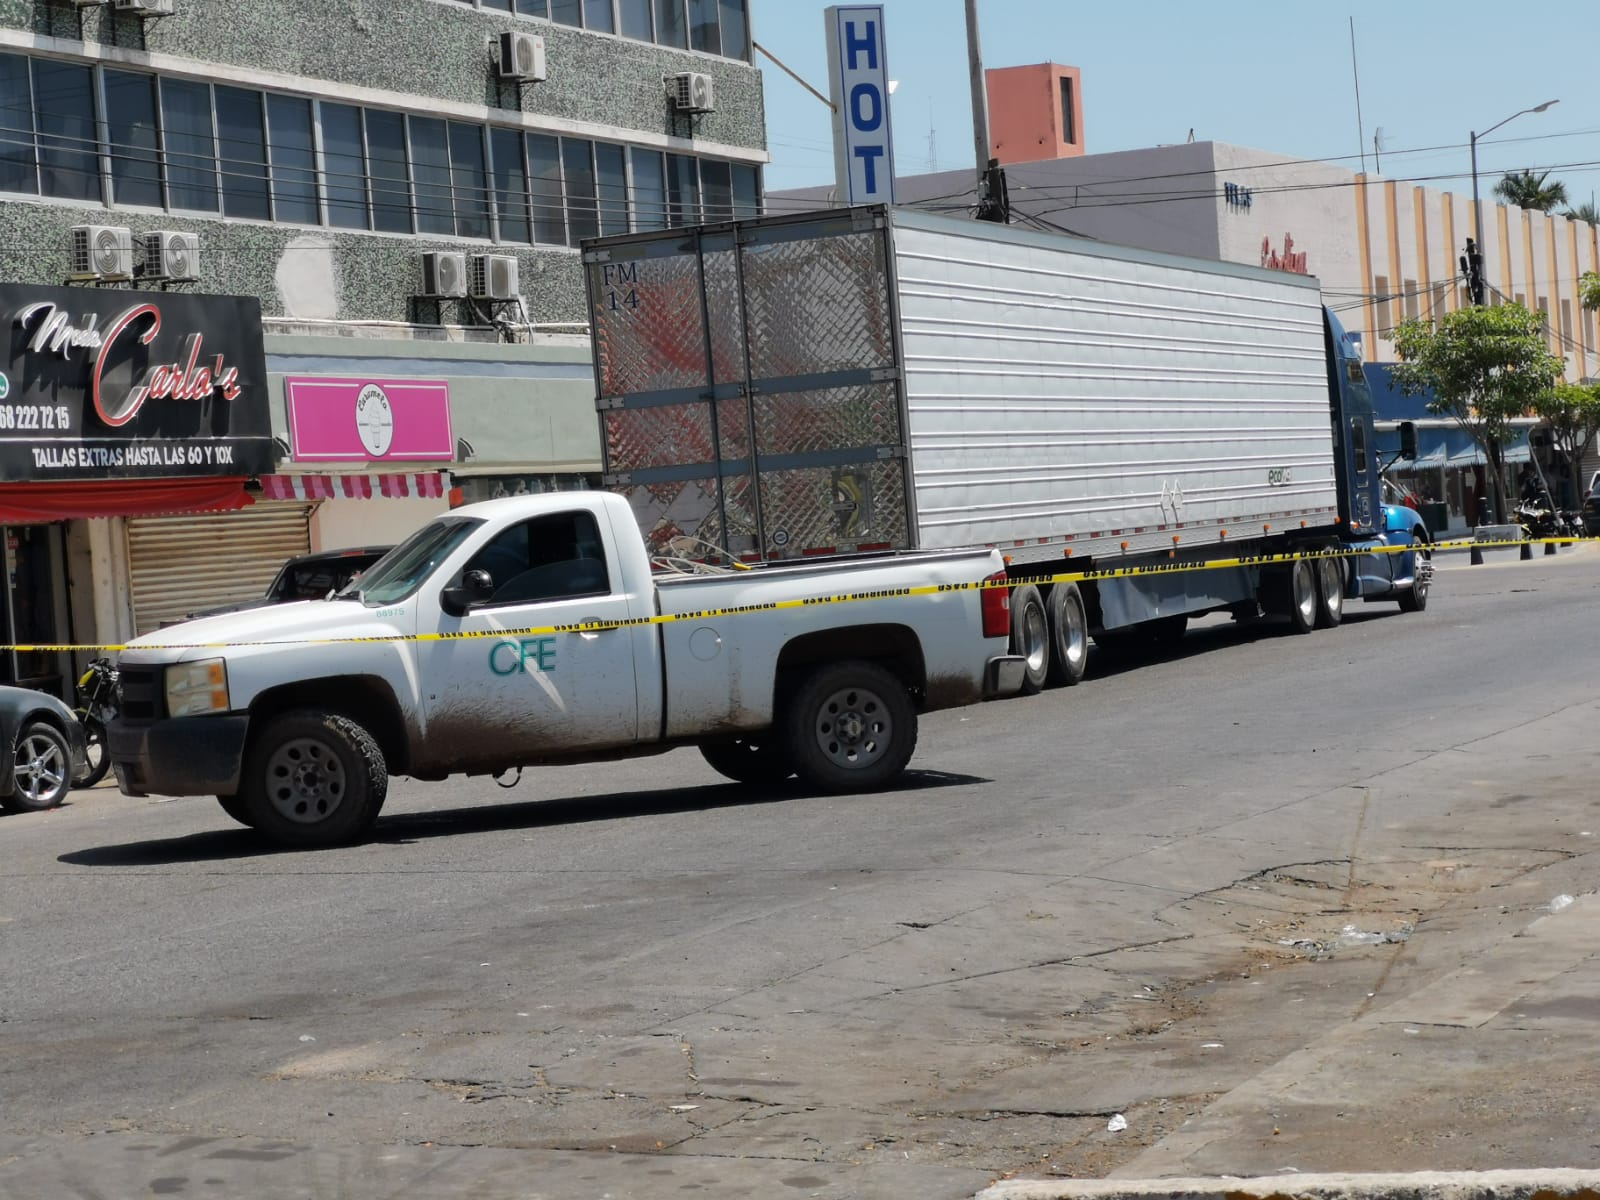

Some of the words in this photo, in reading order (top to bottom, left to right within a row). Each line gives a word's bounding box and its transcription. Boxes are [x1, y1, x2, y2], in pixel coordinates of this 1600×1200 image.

[845, 21, 884, 194] HOT
[601, 262, 638, 286] FM
[607, 289, 640, 311] 14
[93, 303, 241, 427] Carla's
[16, 405, 39, 429] 222
[40, 405, 54, 429] 72
[55, 406, 69, 429] 15
[32, 448, 77, 468] TALLAS
[79, 448, 123, 467] EXTRAS
[126, 448, 161, 466] HASTA
[164, 447, 185, 465] LAS
[188, 447, 202, 465] 60
[205, 447, 213, 463] Y
[214, 446, 233, 464] 10X
[489, 637, 556, 676] CFE
